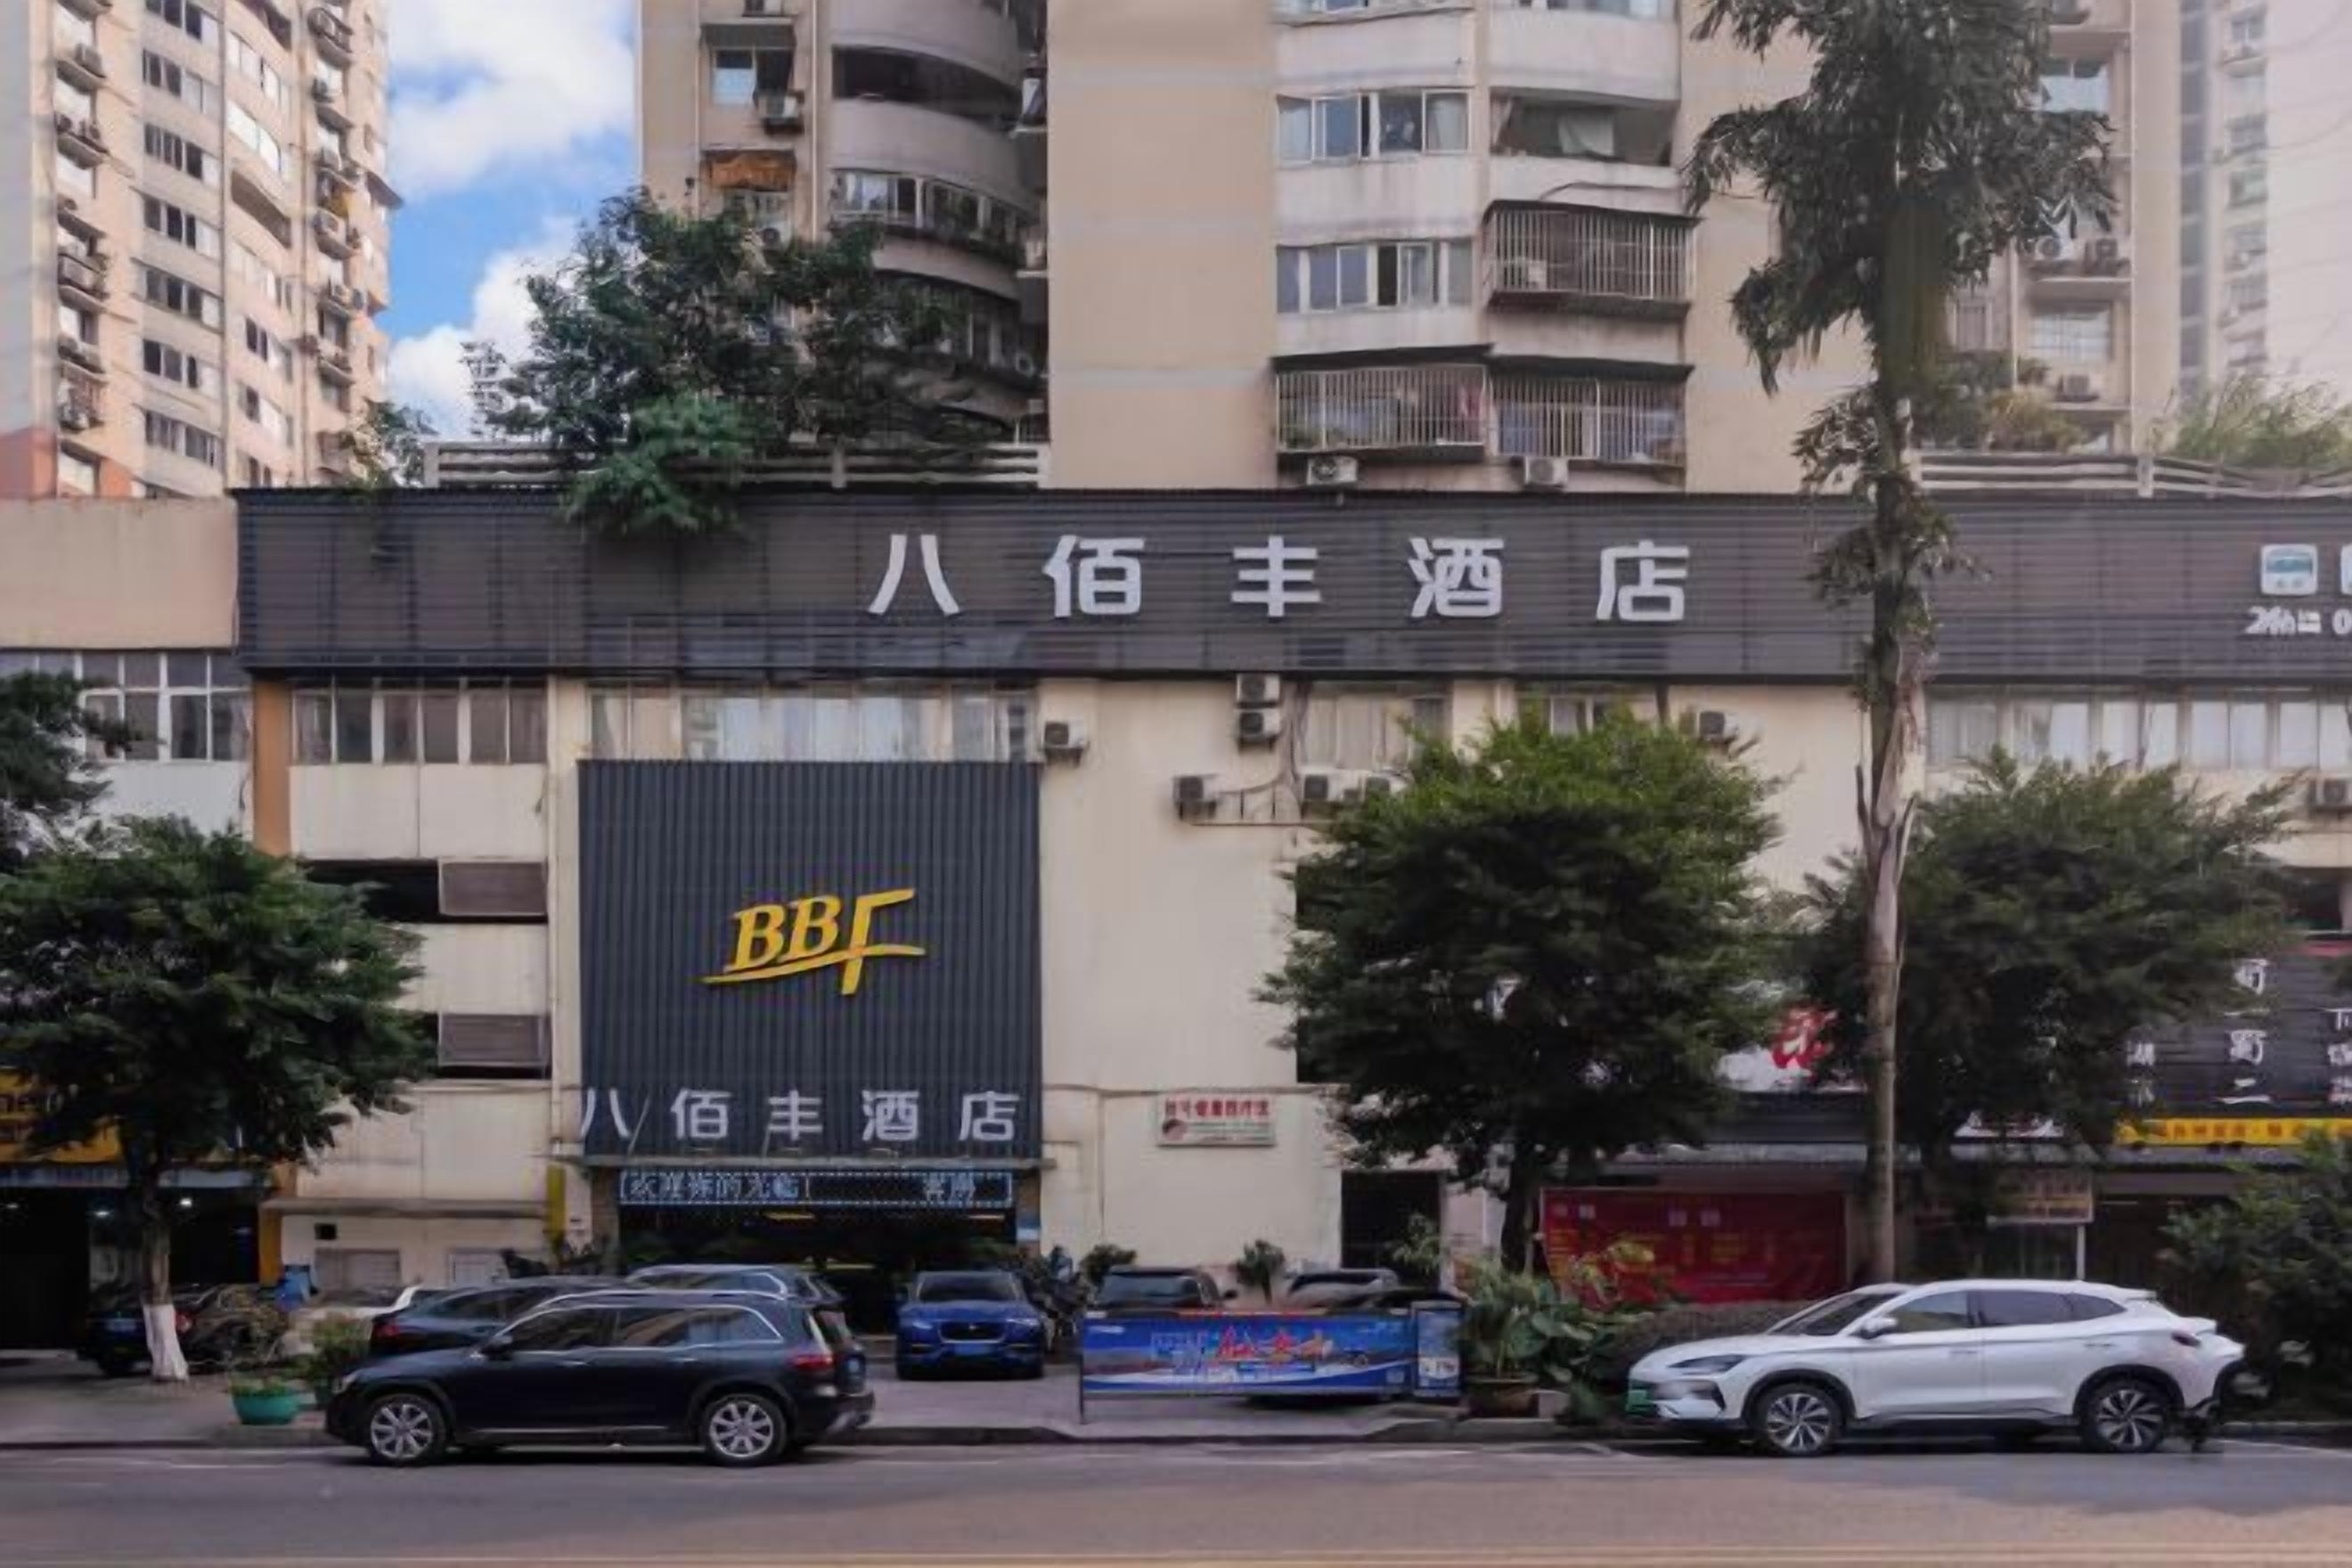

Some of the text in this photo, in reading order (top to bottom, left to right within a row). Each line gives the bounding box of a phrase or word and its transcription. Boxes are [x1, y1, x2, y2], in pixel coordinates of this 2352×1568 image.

[870, 534, 1689, 622] 八佰丰酒店
[699, 888, 925, 995] BBF
[581, 1088, 1020, 1141] 八佰丰酒店
